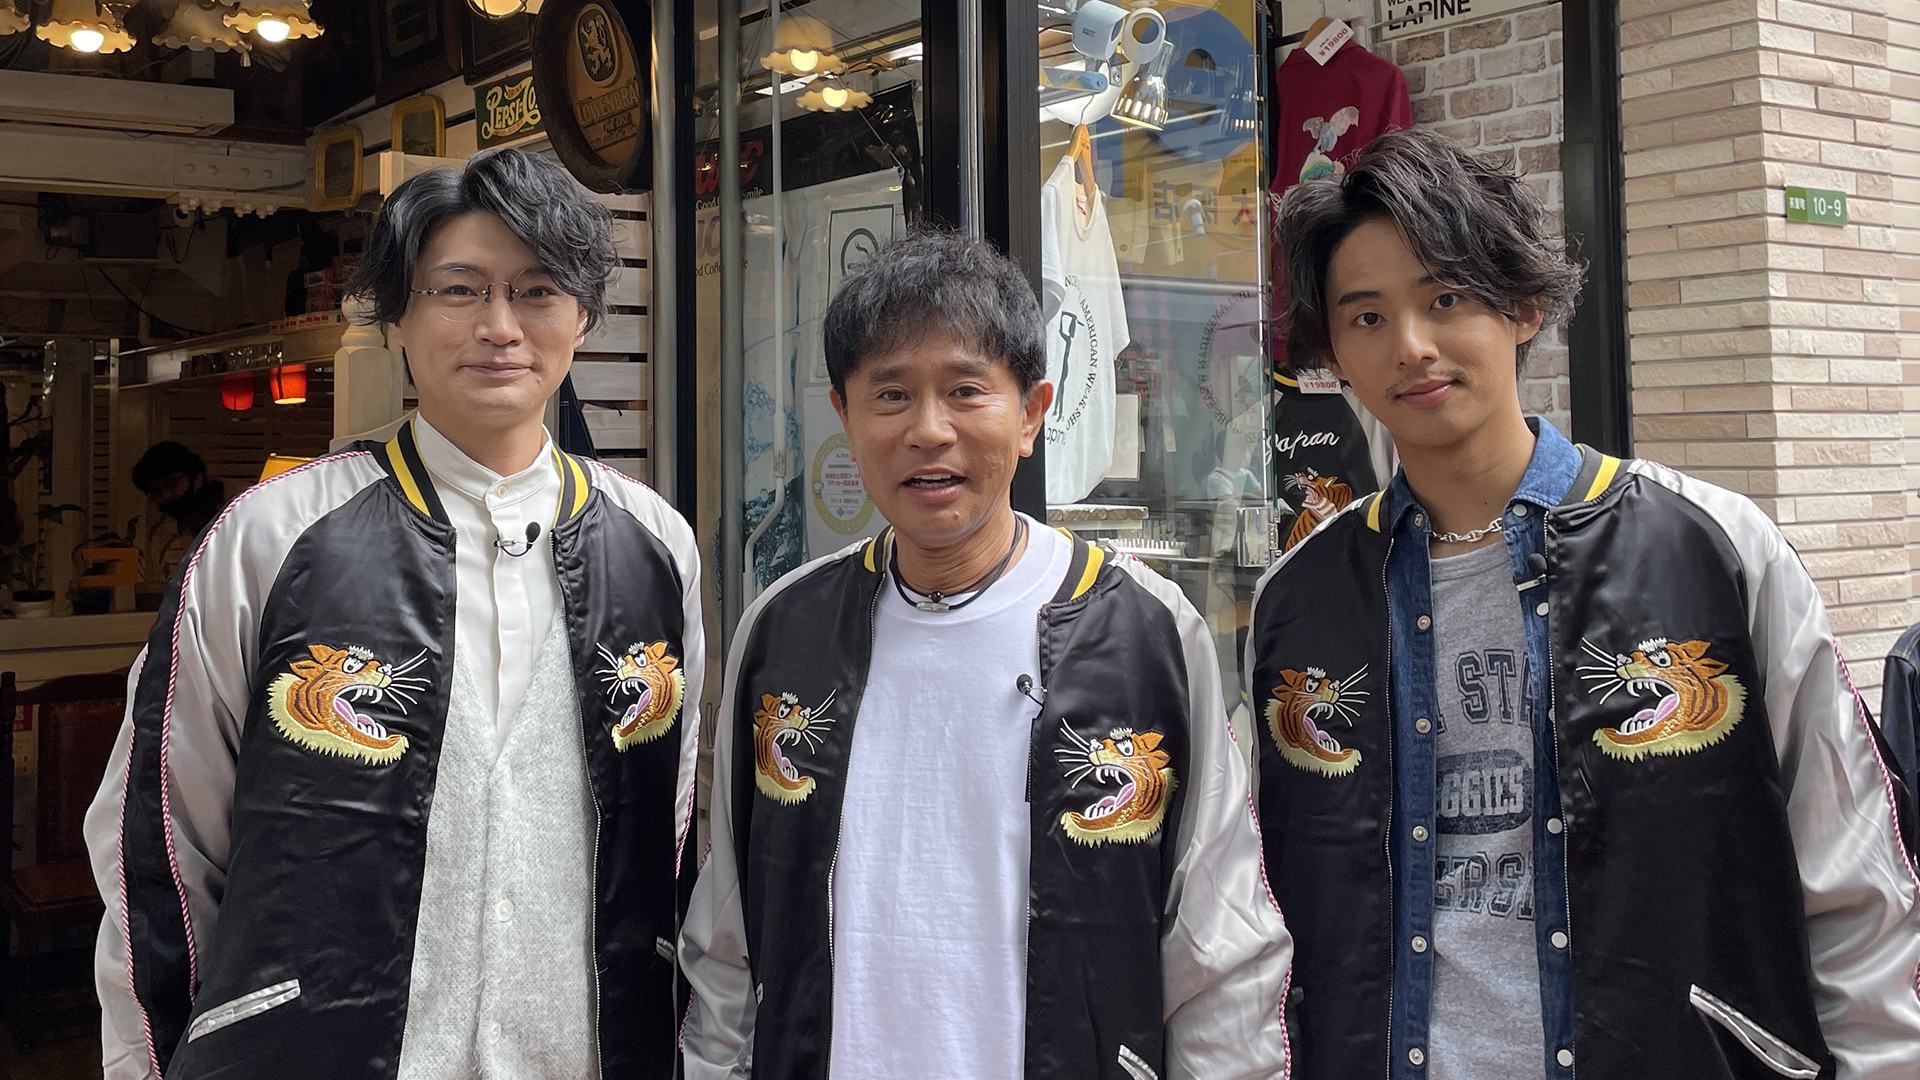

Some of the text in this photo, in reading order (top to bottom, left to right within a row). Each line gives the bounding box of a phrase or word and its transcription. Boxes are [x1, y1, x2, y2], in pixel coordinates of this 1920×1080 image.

[1388, 0, 1472, 31] LAPINE
[1318, 28, 1348, 57] ¥19800
[741, 186, 764, 201] Smile
[1813, 196, 1842, 217] 10-9
[1079, 298, 1098, 369] AMERICAN
[1303, 381, 1337, 390] ¥19800
[1265, 430, 1340, 466] Japan
[1437, 766, 1524, 818] GGIES
